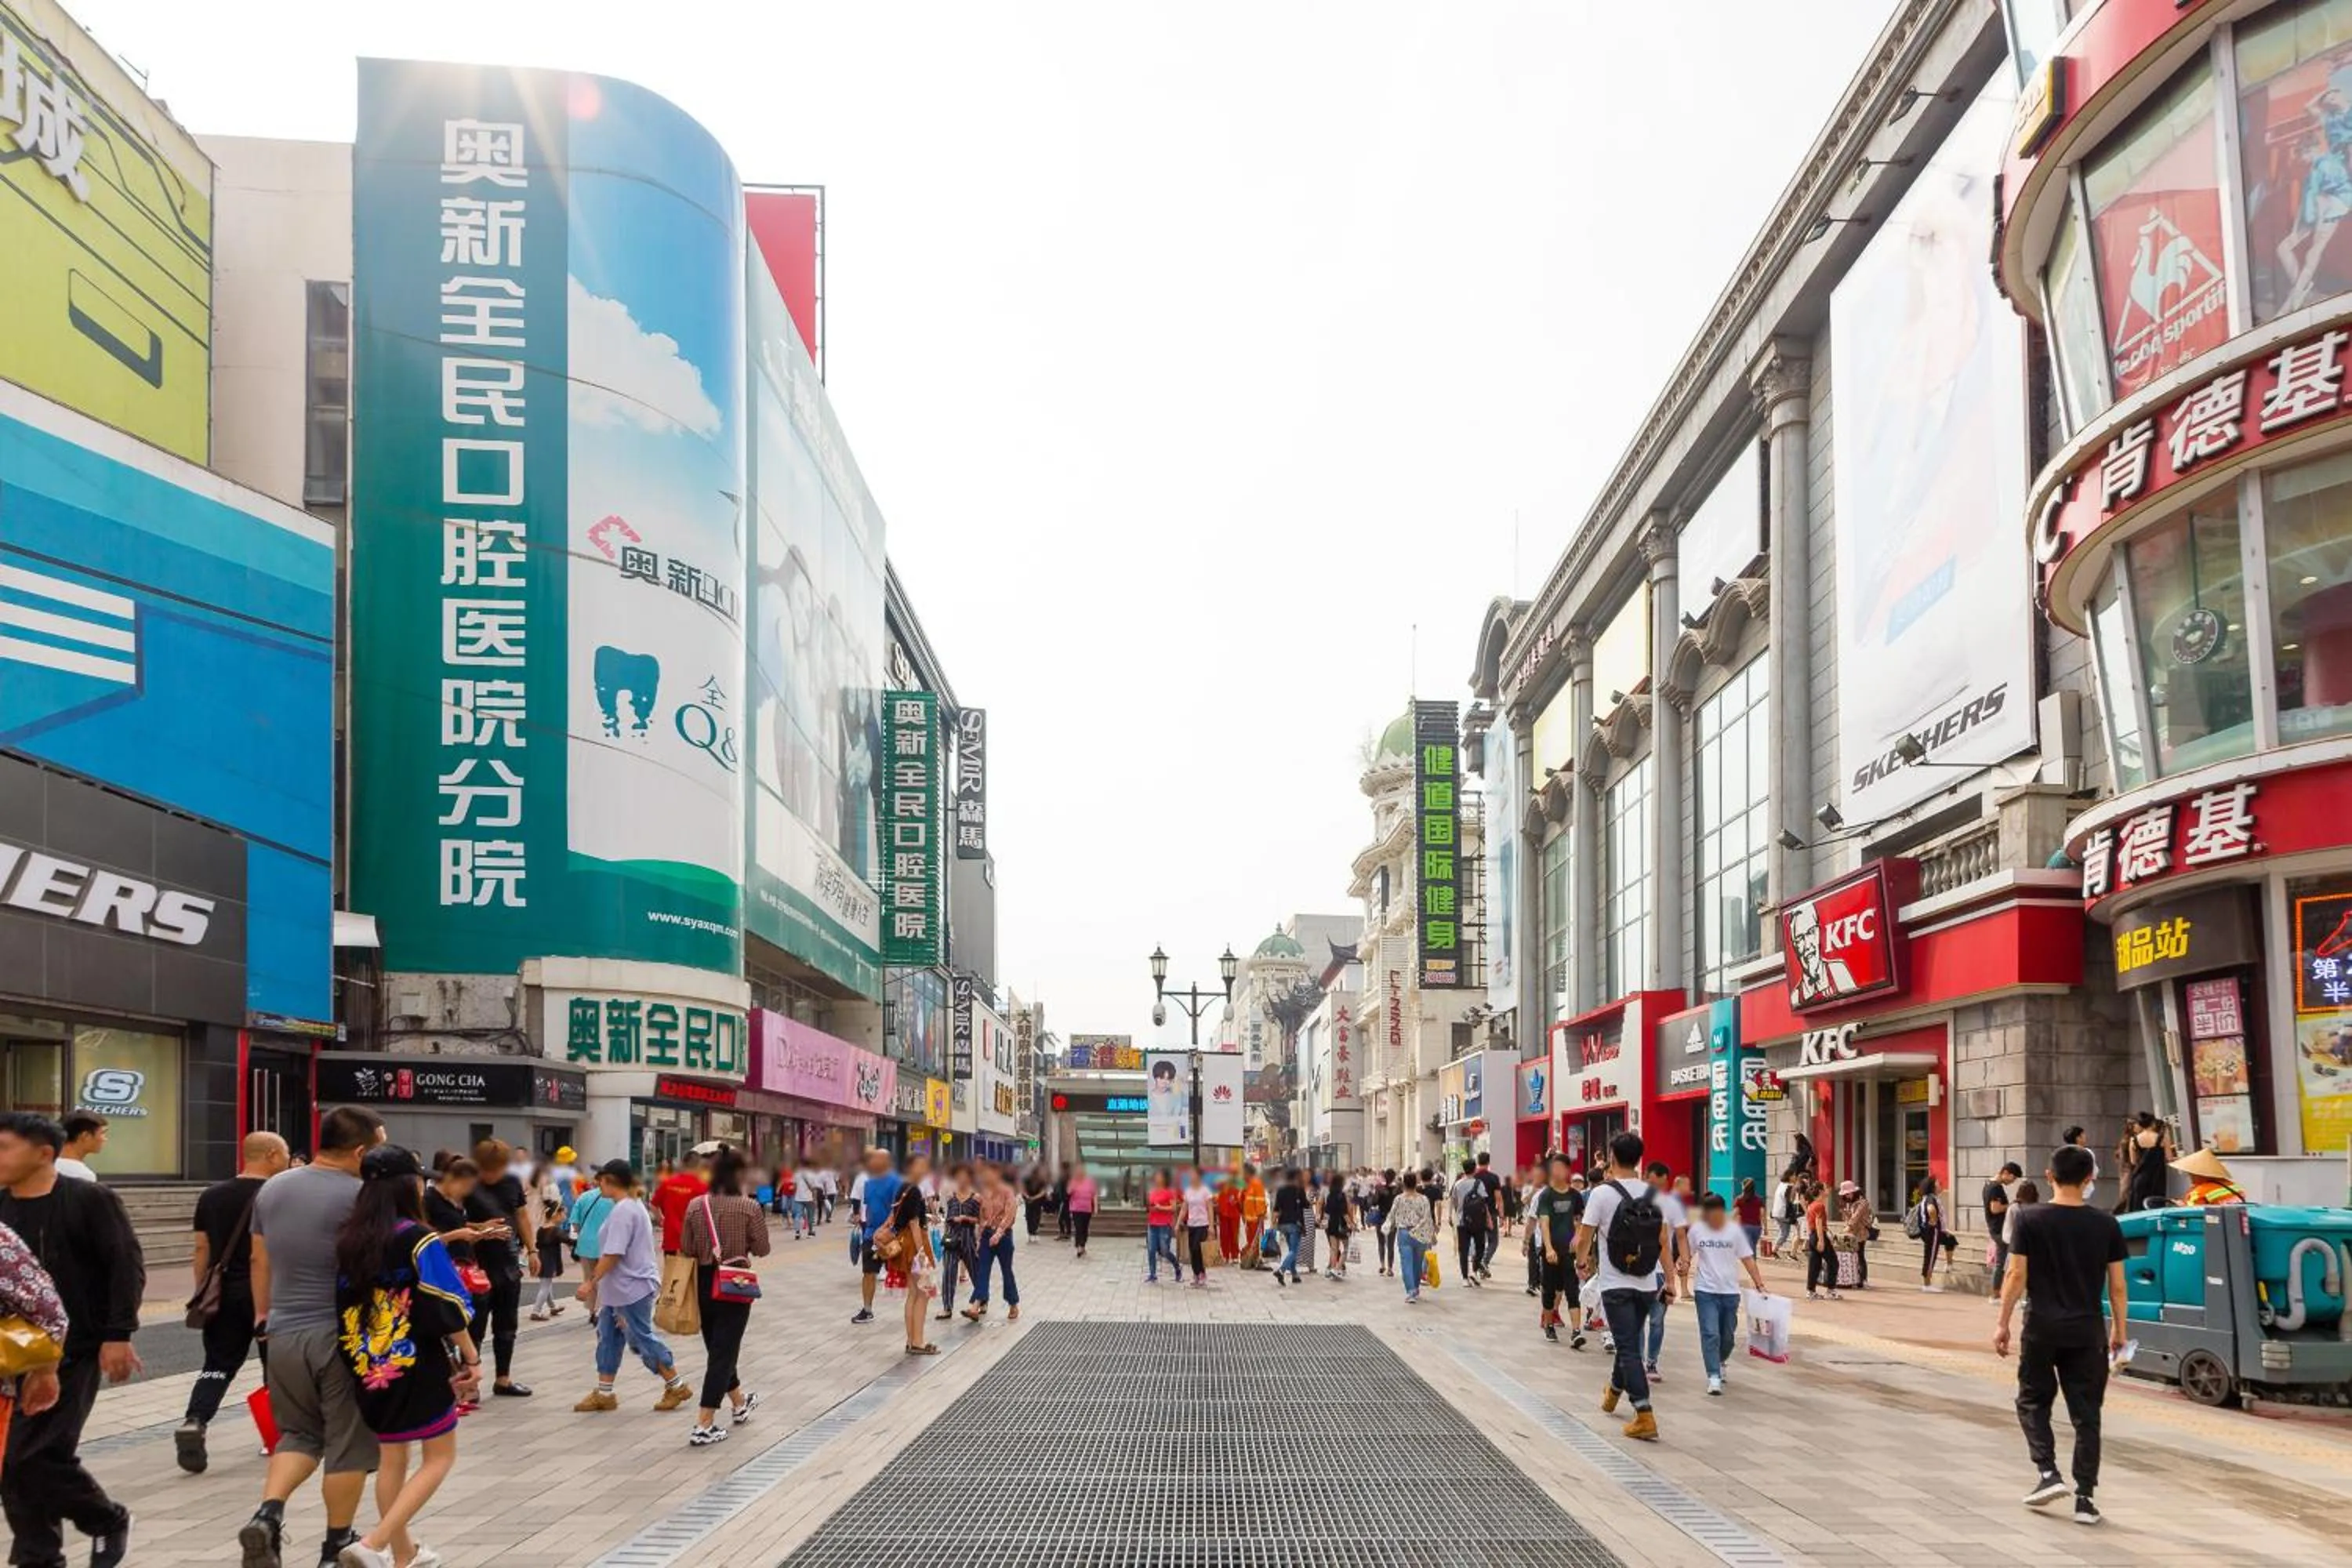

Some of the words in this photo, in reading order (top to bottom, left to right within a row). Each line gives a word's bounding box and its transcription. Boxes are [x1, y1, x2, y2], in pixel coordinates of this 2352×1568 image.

[2101, 332, 2350, 512] 肯德基
[439, 119, 528, 907] 奥新全民口腔医院分院
[1851, 681, 2008, 794] SKEHERS
[895, 699, 927, 939] 奥新全民口腔医院
[1424, 745, 1456, 951] 健道国际健身
[2082, 784, 2256, 898] 肯德基
[1824, 908, 1877, 953] KFC
[2117, 916, 2191, 974] 甜品站
[416, 1073, 456, 1087] GONG
[459, 1073, 485, 1087] CHA
[1800, 1022, 1859, 1066] KFC
